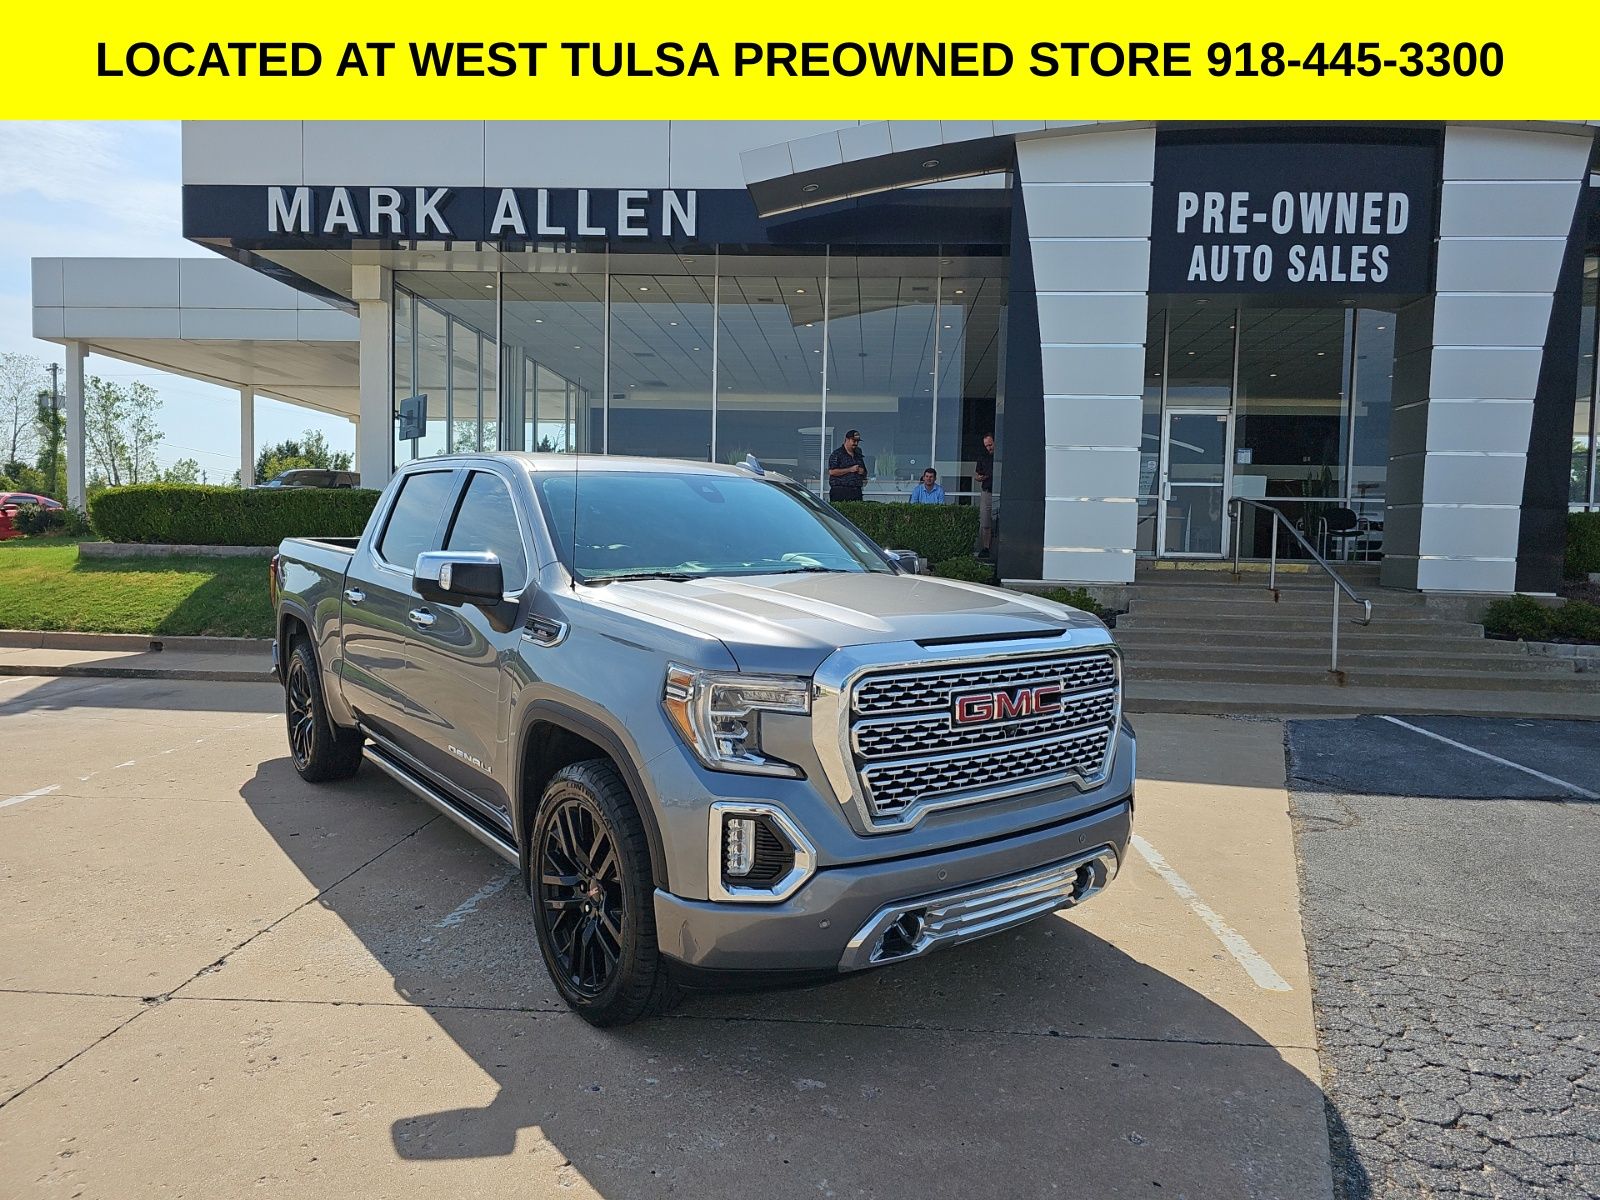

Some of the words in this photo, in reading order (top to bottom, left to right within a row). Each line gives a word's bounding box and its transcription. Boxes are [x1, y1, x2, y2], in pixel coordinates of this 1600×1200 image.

[267, 186, 451, 234] MARK
[490, 188, 697, 237] ALLEN
[1176, 191, 1410, 235] PRE-OWNED
[1187, 244, 1273, 283] AUTO
[1287, 244, 1390, 283] SALES
[955, 684, 1061, 724] GMC
[447, 744, 493, 775] DENALI
